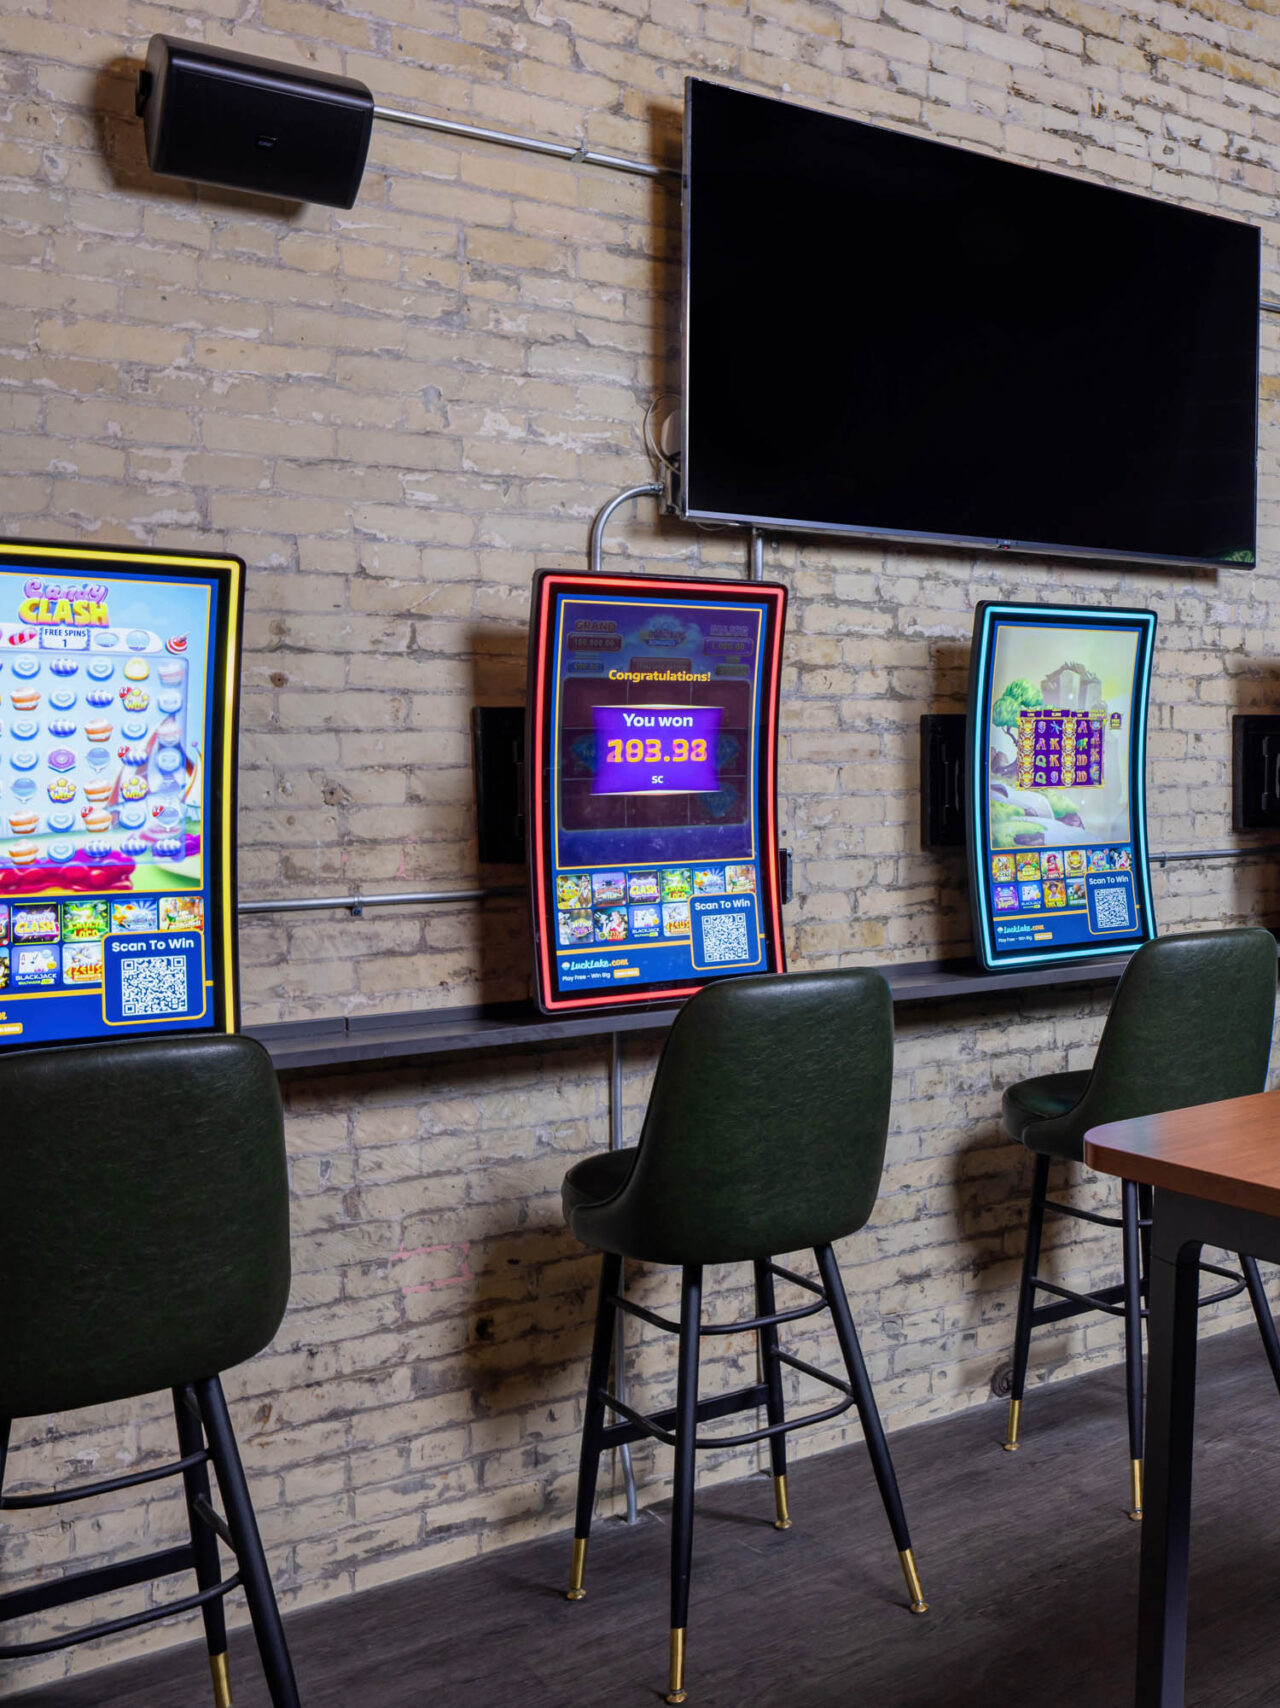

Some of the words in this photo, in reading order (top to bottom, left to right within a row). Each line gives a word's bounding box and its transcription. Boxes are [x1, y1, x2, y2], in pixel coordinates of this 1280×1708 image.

[24, 578, 108, 602] Candy
[19, 598, 110, 628] CLASH
[44, 629, 64, 637] FREE
[65, 630, 87, 638] SPINS
[63, 639, 67, 648] 1
[608, 670, 711, 682] Congratulations!
[622, 713, 655, 727] You
[659, 716, 694, 727] won
[1089, 877, 1106, 885] Scan
[1116, 875, 1129, 883] Win
[694, 902, 718, 911] Scan
[720, 901, 732, 910] To
[732, 899, 751, 908] Win
[16, 922, 55, 934] CLASH
[111, 941, 146, 952] Scan
[149, 939, 166, 950] To
[168, 937, 195, 948] Win
[15, 973, 57, 981] BLACKJACK
